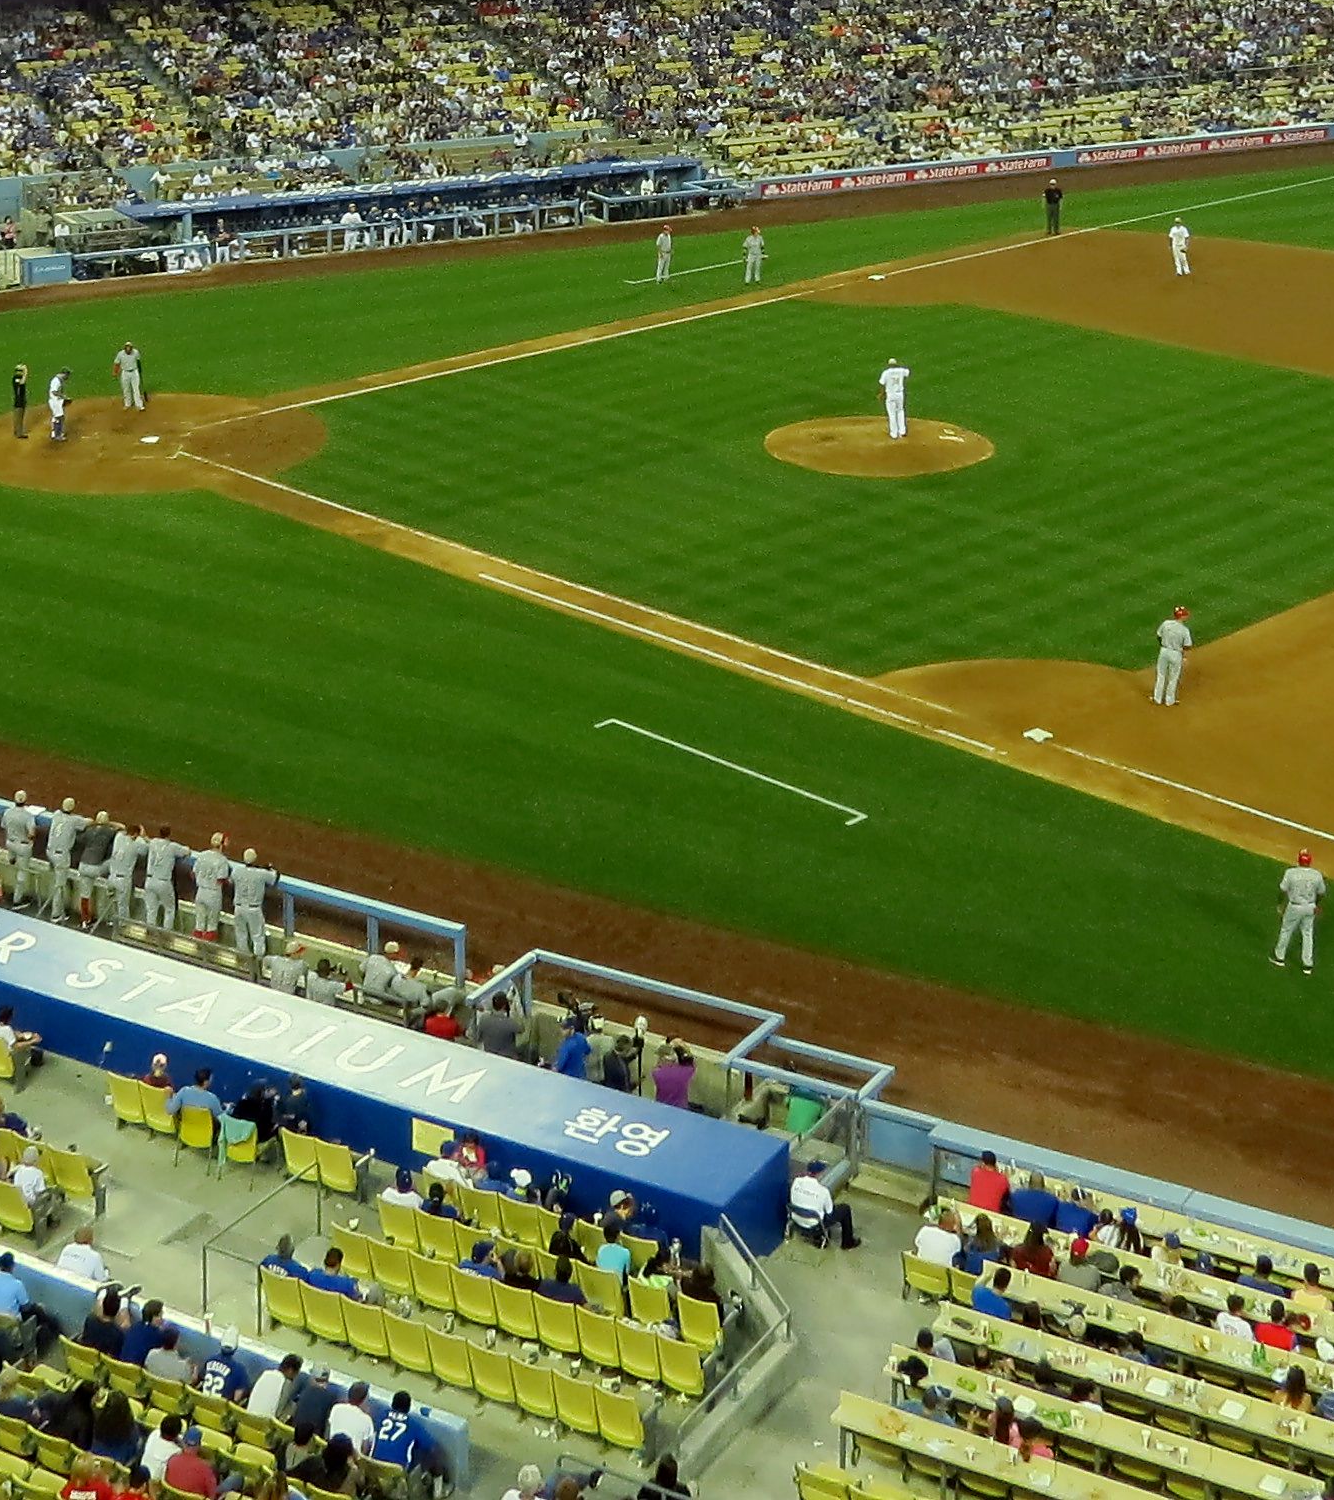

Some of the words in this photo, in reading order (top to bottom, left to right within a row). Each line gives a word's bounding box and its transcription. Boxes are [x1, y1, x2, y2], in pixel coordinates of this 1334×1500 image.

[66, 957, 489, 1104] STADIUM
[563, 1106, 671, 1157] 환영
[203, 1373, 225, 1397] 22
[378, 1418, 407, 1441] 27
